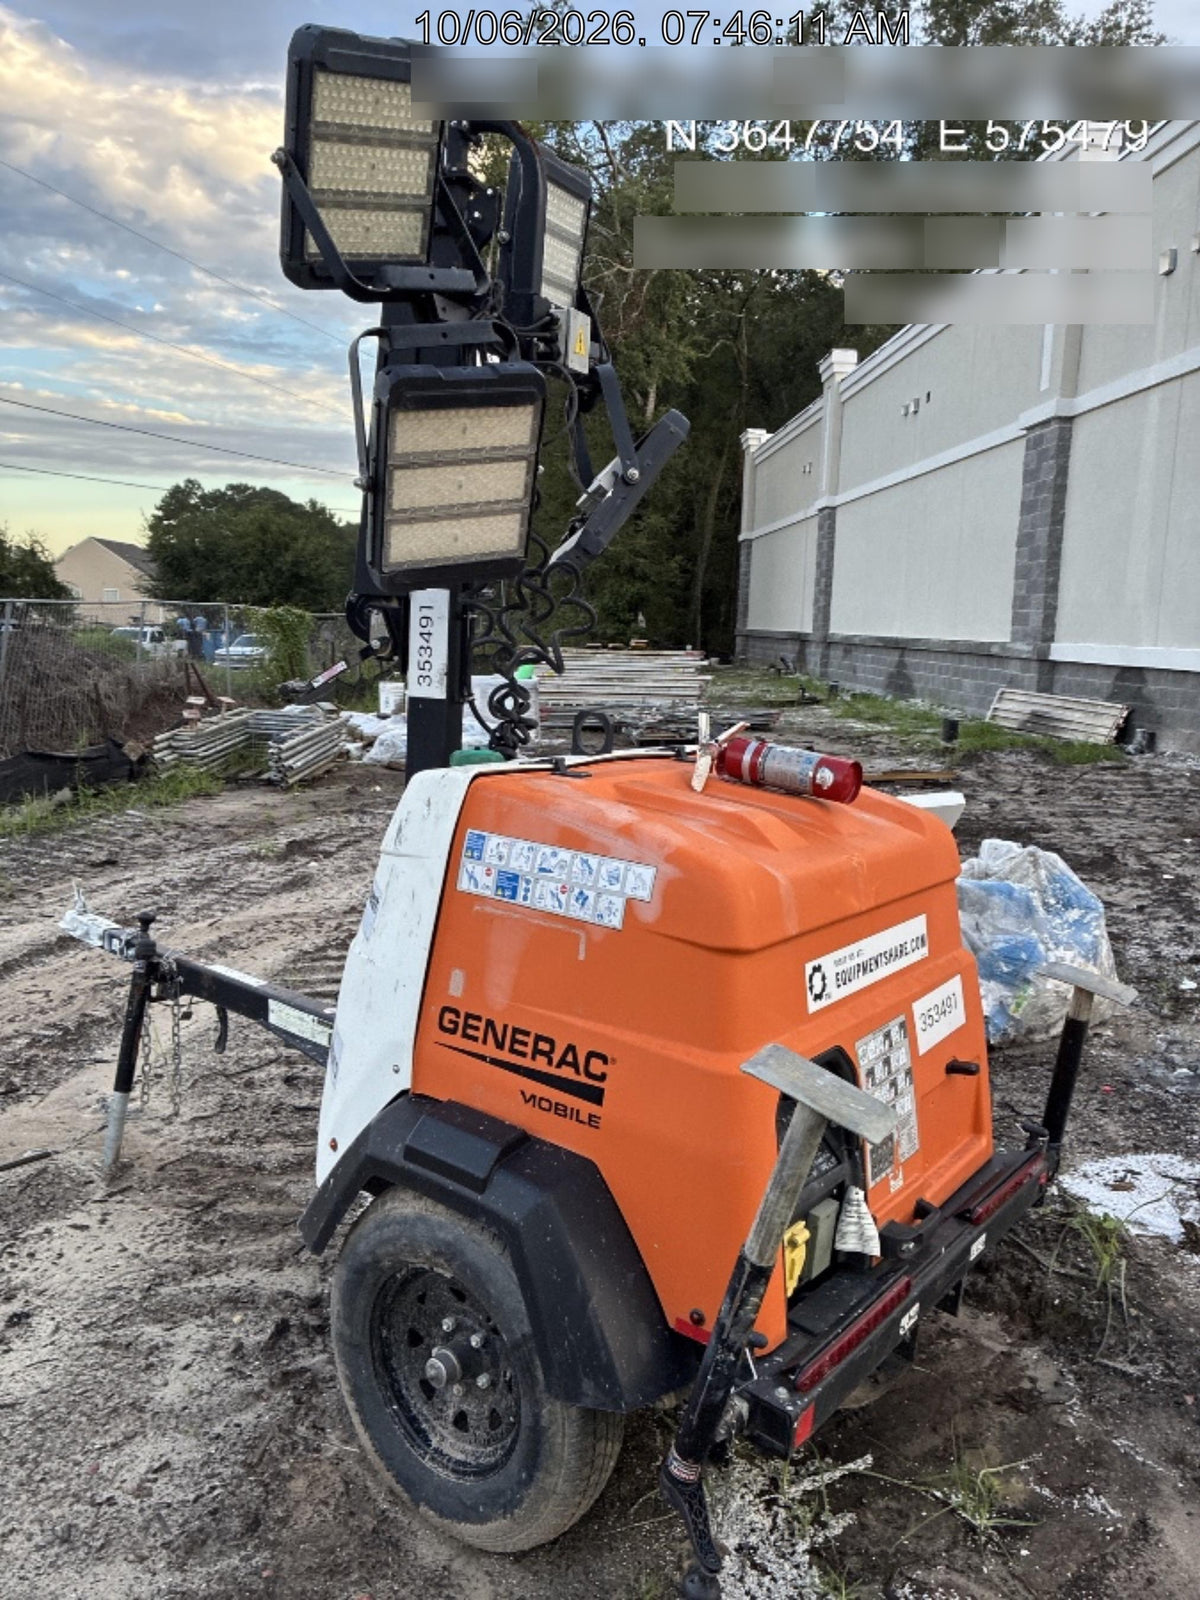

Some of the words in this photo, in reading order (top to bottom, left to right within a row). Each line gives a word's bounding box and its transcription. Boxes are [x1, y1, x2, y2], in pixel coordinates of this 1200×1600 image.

[417, 605, 434, 687] 353491
[835, 933, 927, 989] EQUIPMENTSHARE.COM
[919, 992, 958, 1032] 353491
[438, 1005, 607, 1083] GENERAC
[520, 1090, 602, 1129] MOBILE
